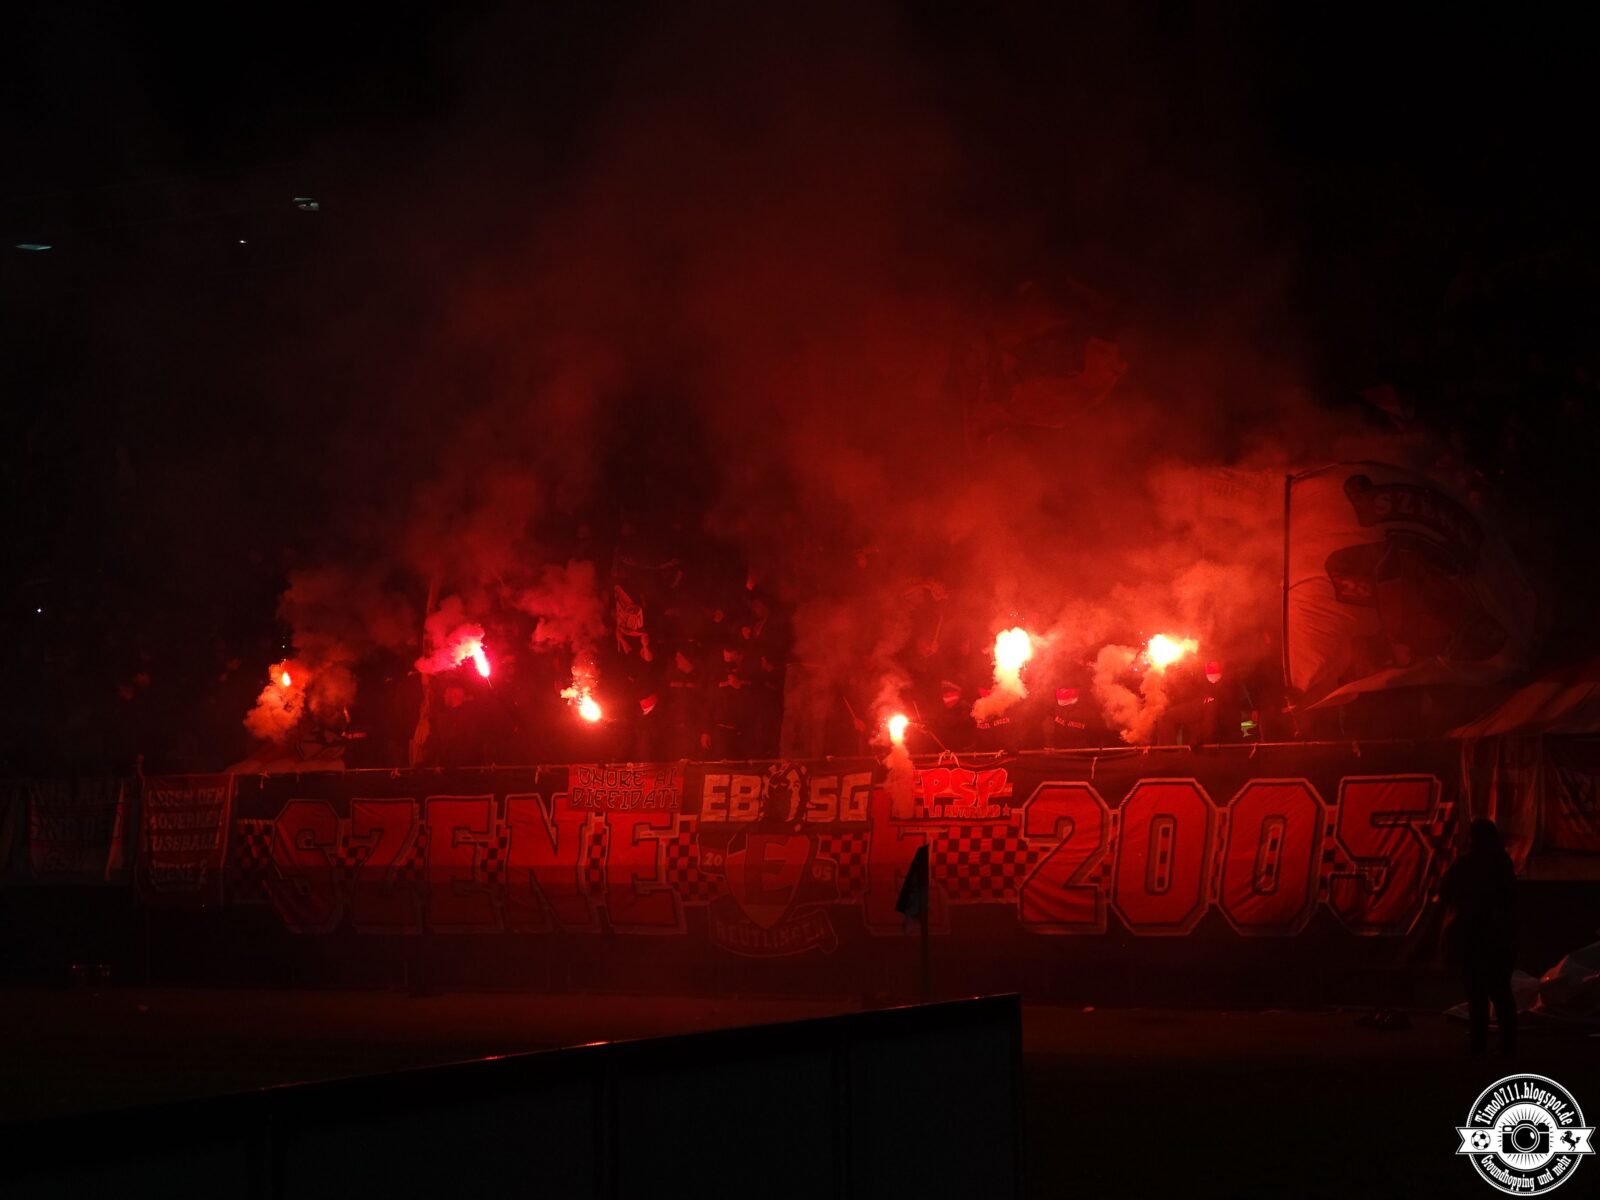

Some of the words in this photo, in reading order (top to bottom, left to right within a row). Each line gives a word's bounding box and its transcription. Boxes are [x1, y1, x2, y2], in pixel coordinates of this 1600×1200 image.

[578, 766, 646, 788] ONORE
[271, 793, 688, 935] SZENE
[1018, 773, 1443, 937] 2005
[703, 851, 723, 866] 20
[811, 863, 833, 881] 05
